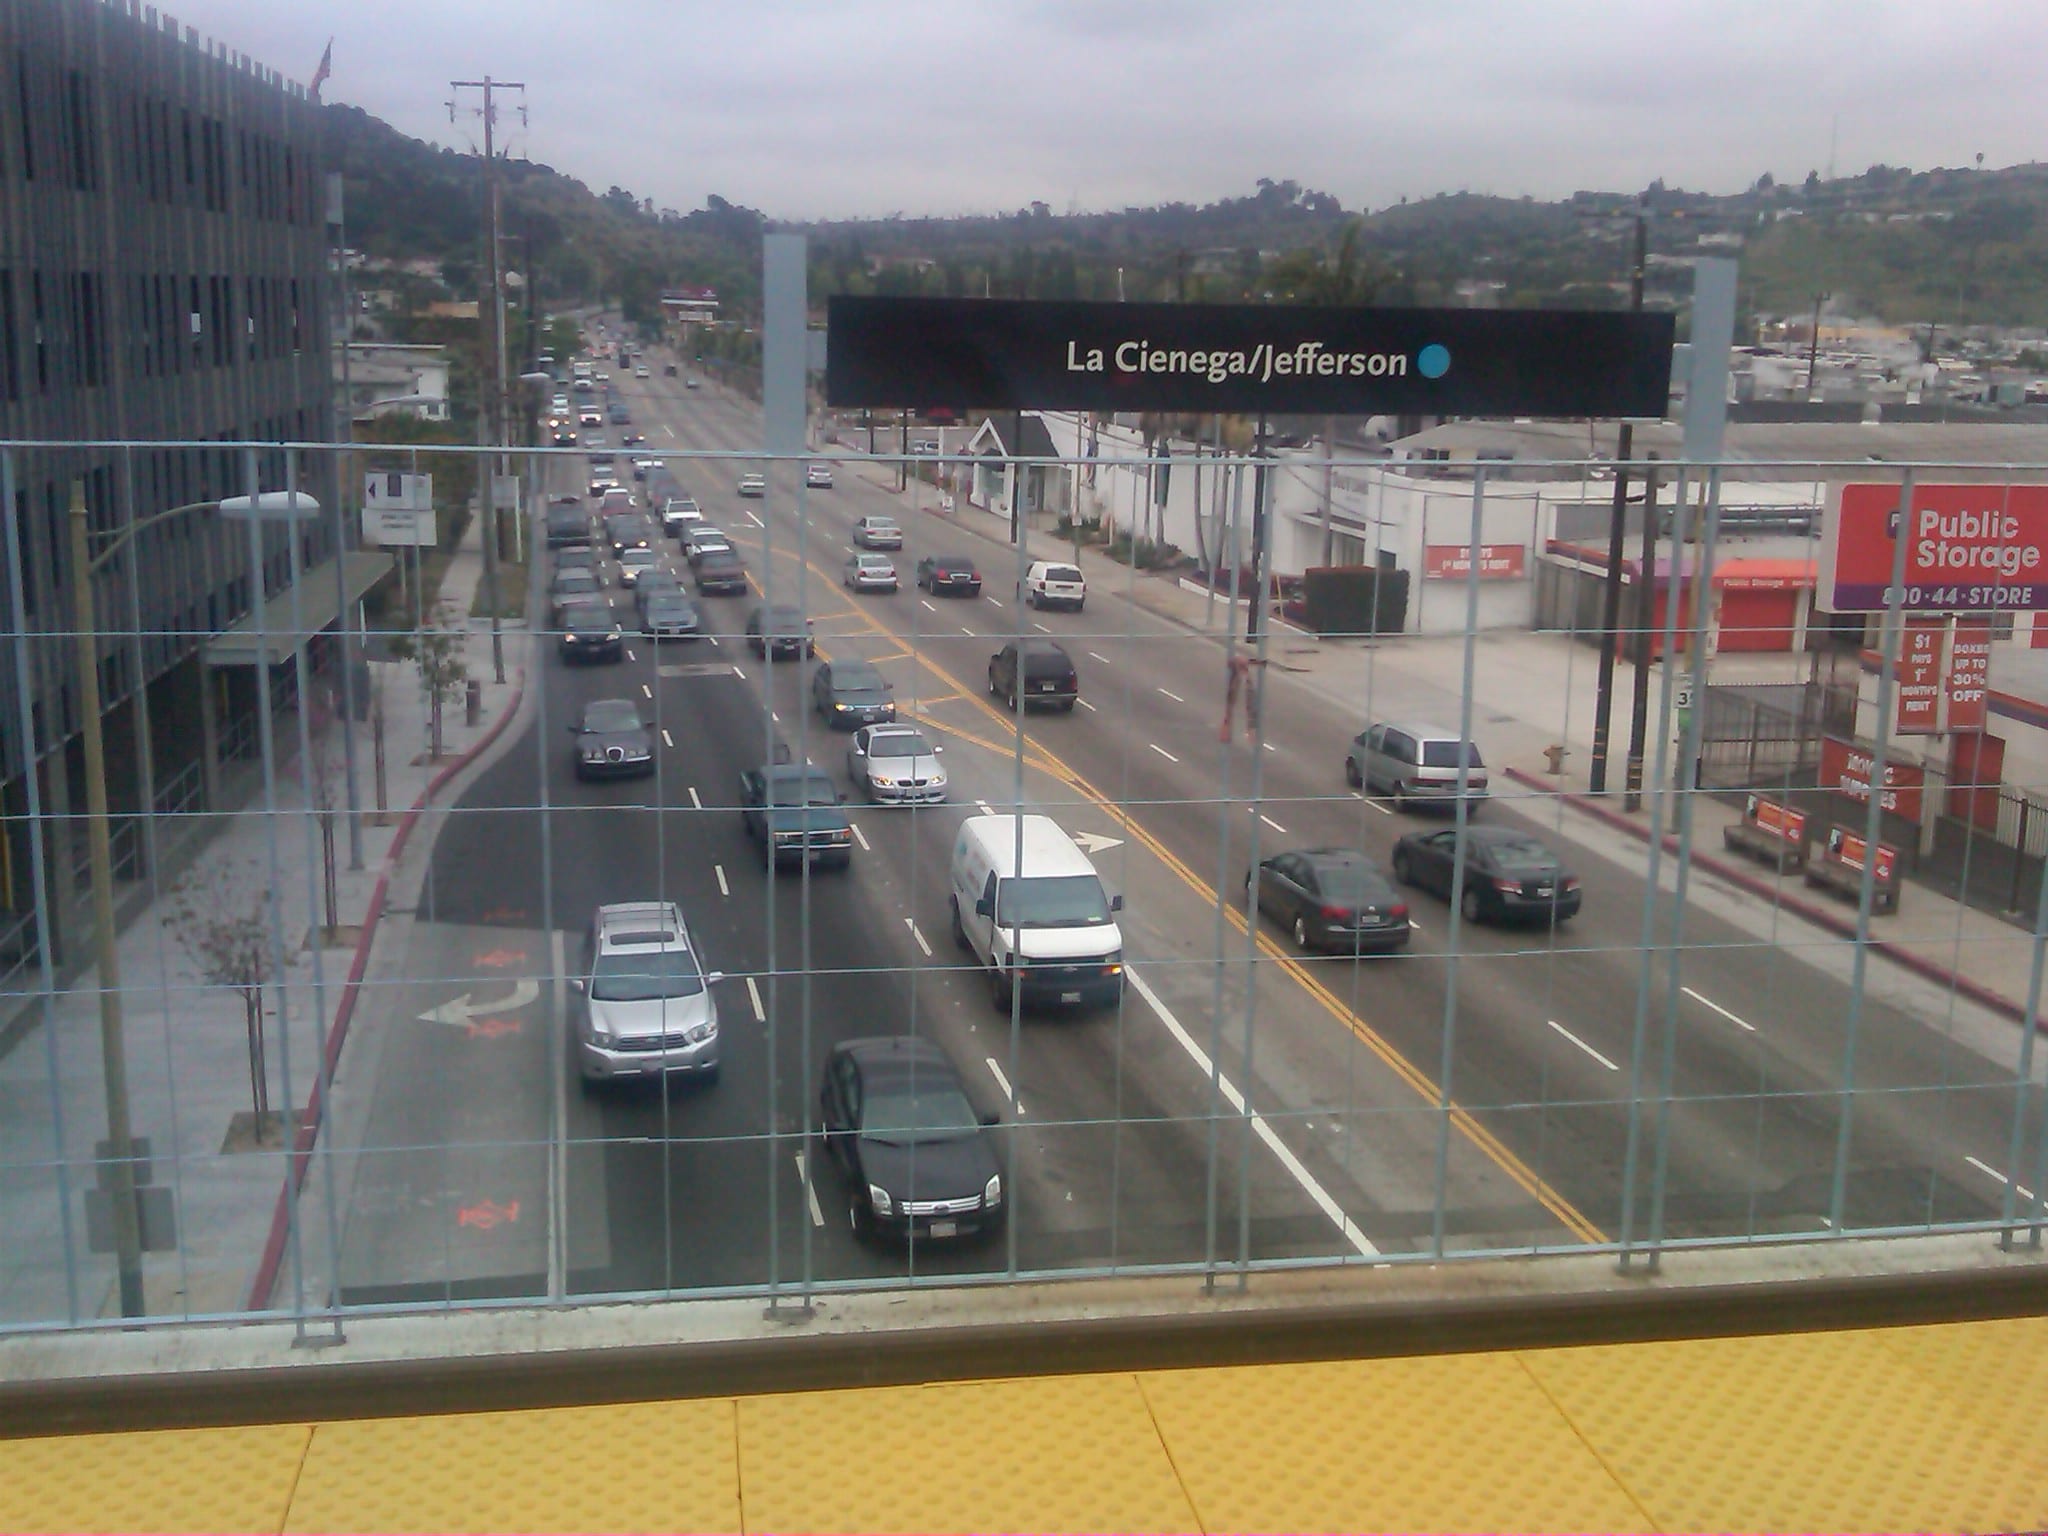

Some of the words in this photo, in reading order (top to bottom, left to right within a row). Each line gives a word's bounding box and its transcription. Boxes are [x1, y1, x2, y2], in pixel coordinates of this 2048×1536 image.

[1066, 340, 1104, 371] La
[1114, 340, 1408, 383] Cienega/Jefferson
[1919, 510, 2020, 539] Public
[1917, 539, 2042, 577] Storage
[1914, 634, 1931, 649] $1
[1955, 658, 1969, 670] UP
[1972, 658, 1986, 669] TO
[1953, 673, 1986, 685] 30%
[1952, 689, 1986, 702] OFF
